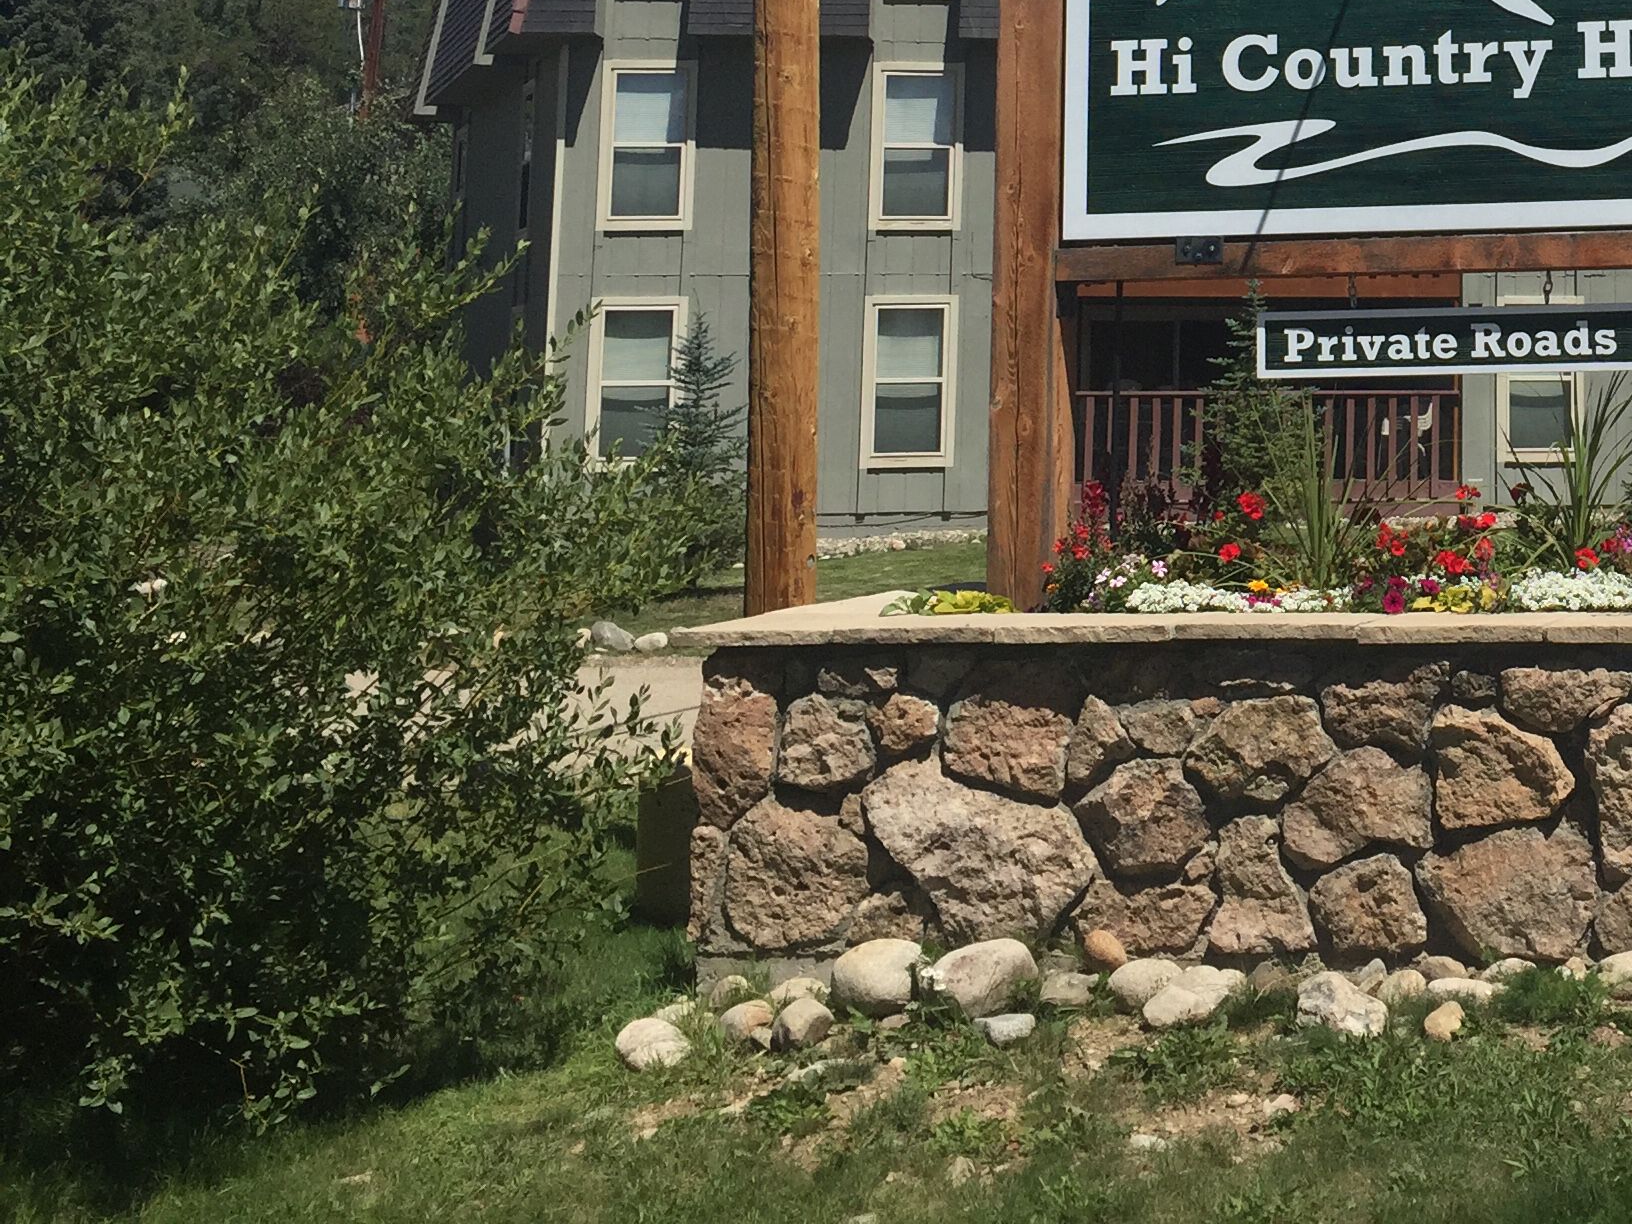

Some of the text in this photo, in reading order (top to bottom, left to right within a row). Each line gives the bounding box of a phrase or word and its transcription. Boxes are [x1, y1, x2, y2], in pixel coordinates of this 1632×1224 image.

[1110, 36, 1197, 96] Hi
[1221, 30, 1553, 99] Country
[1283, 320, 1618, 363] Private Roads
